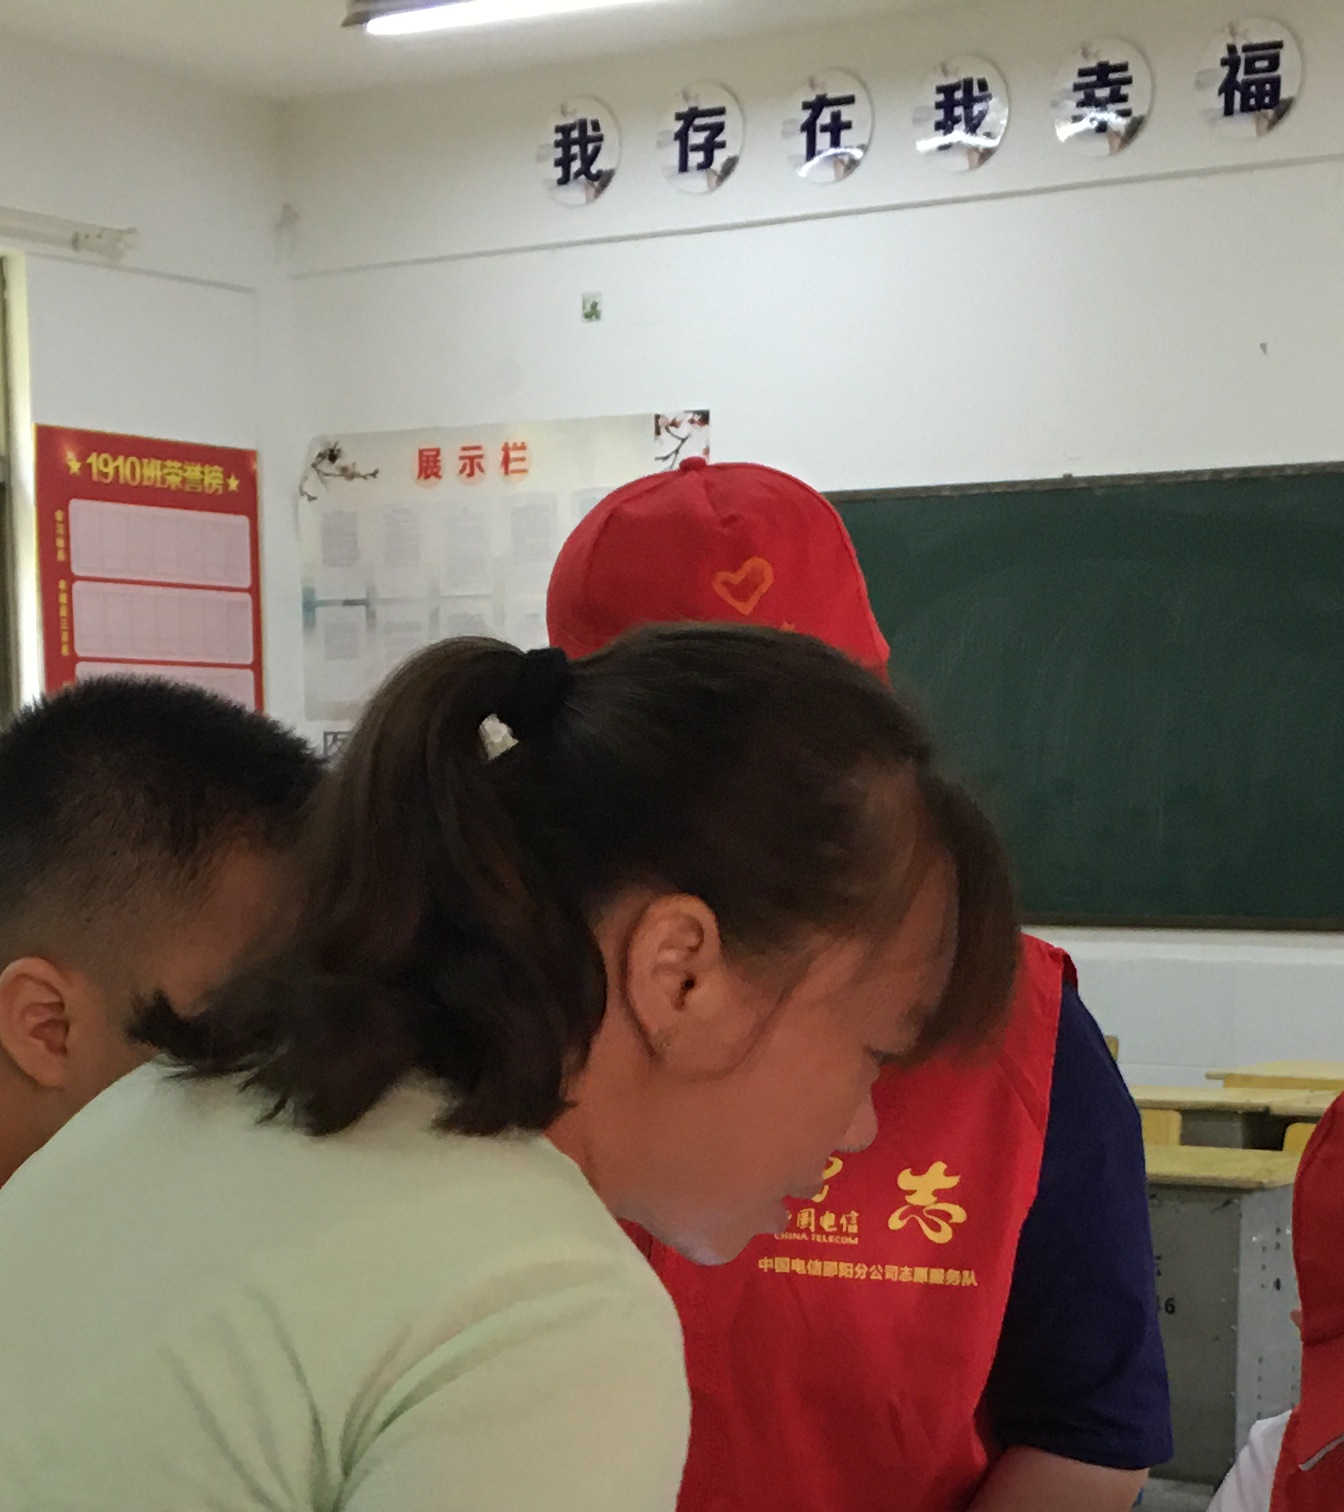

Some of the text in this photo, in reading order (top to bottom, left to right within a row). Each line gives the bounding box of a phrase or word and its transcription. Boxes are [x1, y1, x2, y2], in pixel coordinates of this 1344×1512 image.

[86, 451, 224, 496] 1910班荣誉榜
[416, 441, 529, 481] 展示栏
[787, 1207, 860, 1234] 国电信
